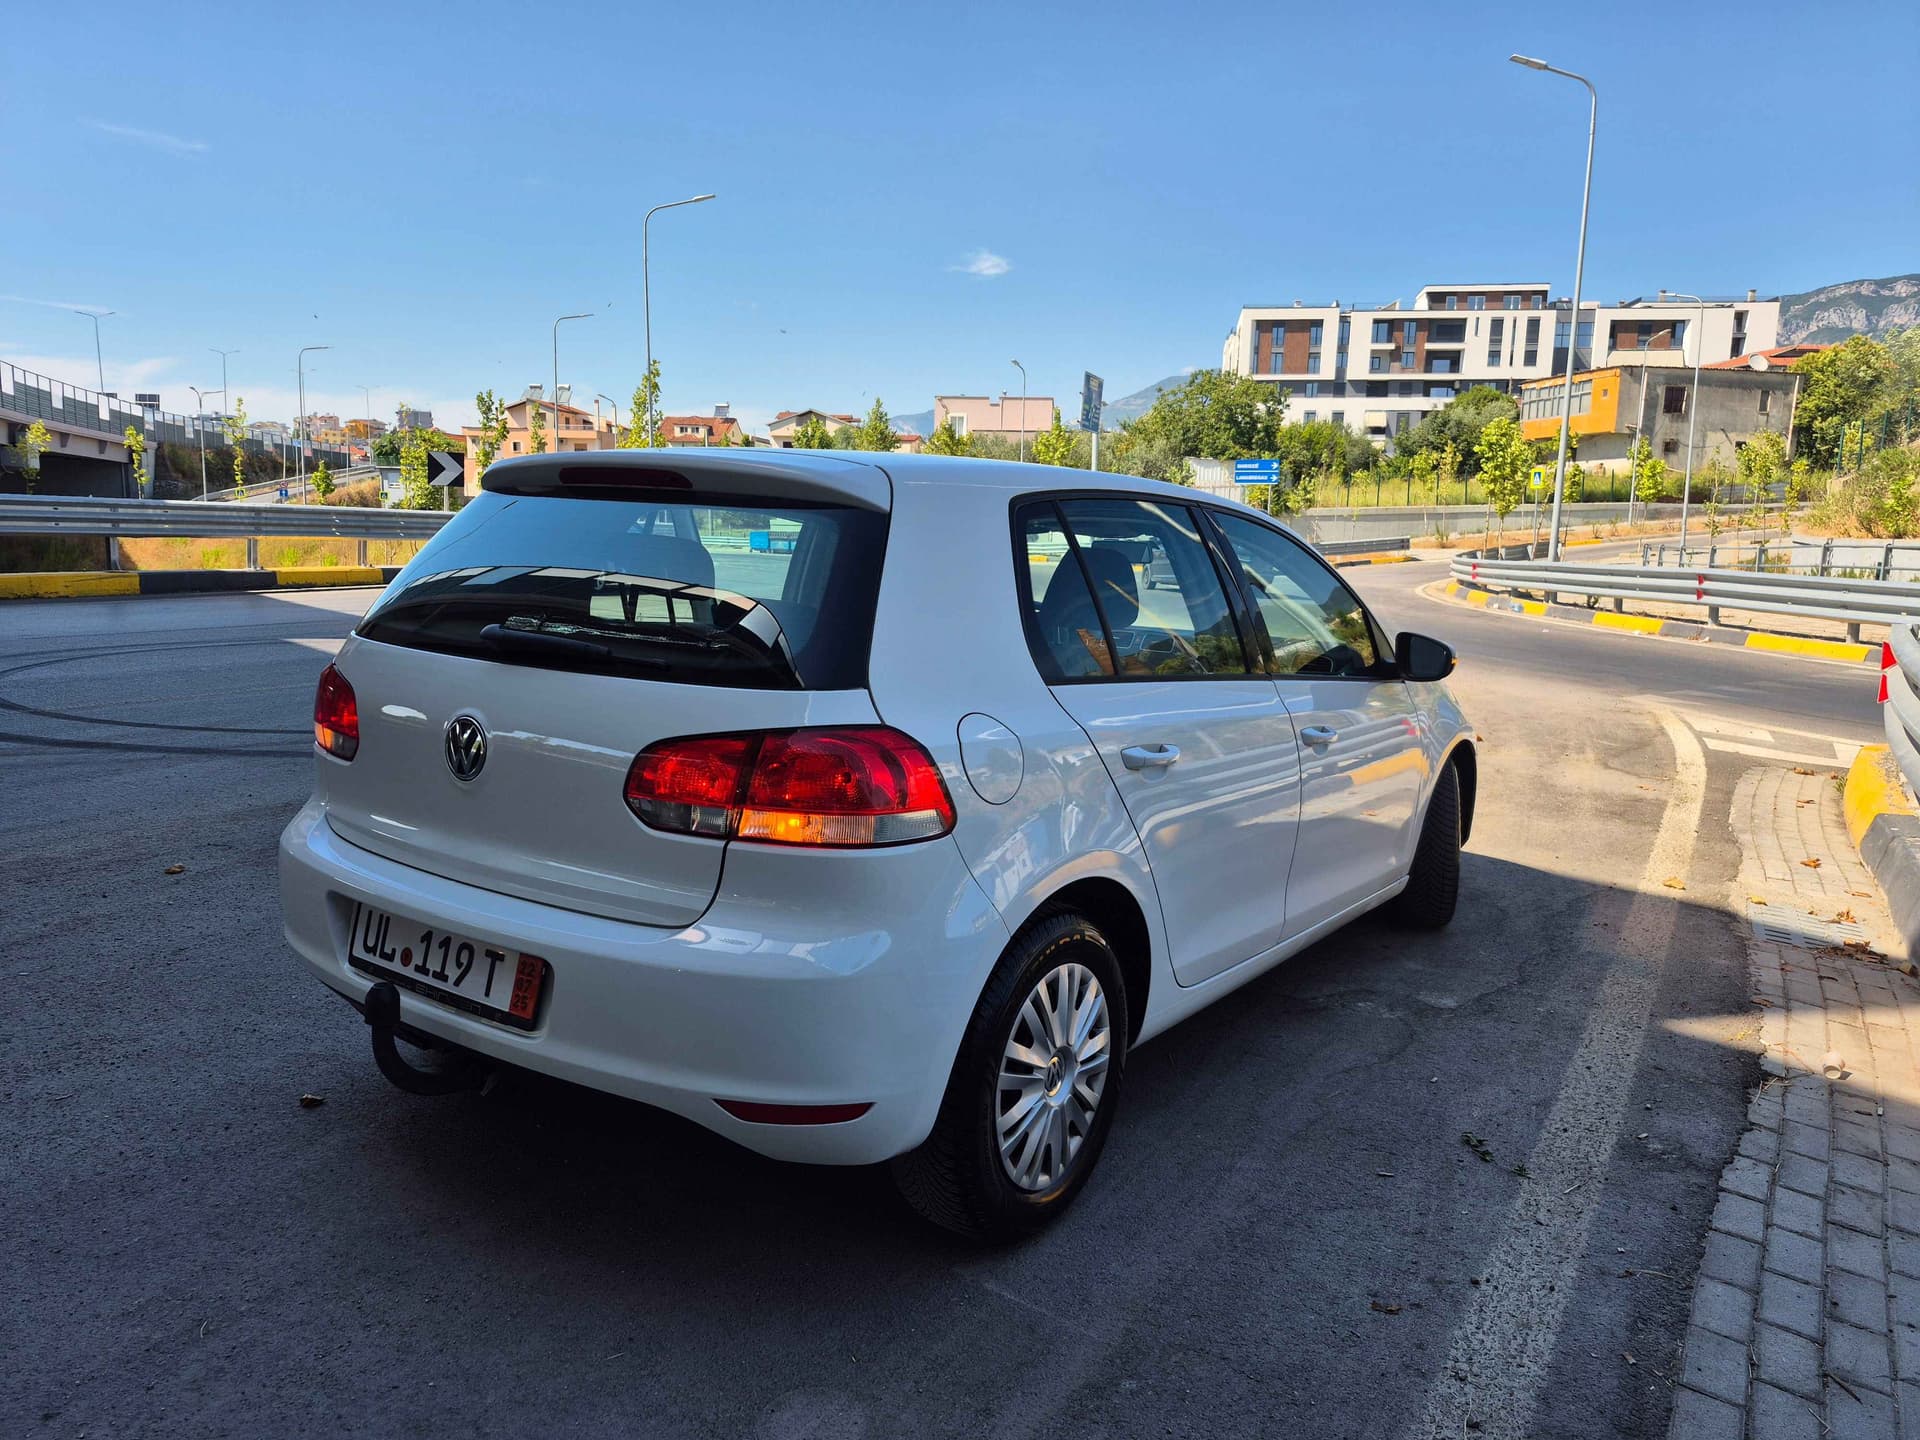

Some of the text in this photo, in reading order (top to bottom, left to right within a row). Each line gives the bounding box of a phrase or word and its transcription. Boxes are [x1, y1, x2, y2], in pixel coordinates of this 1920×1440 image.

[446, 716, 487, 780] VW
[363, 909, 397, 962] UL
[414, 930, 475, 987] 119
[484, 948, 506, 998] T
